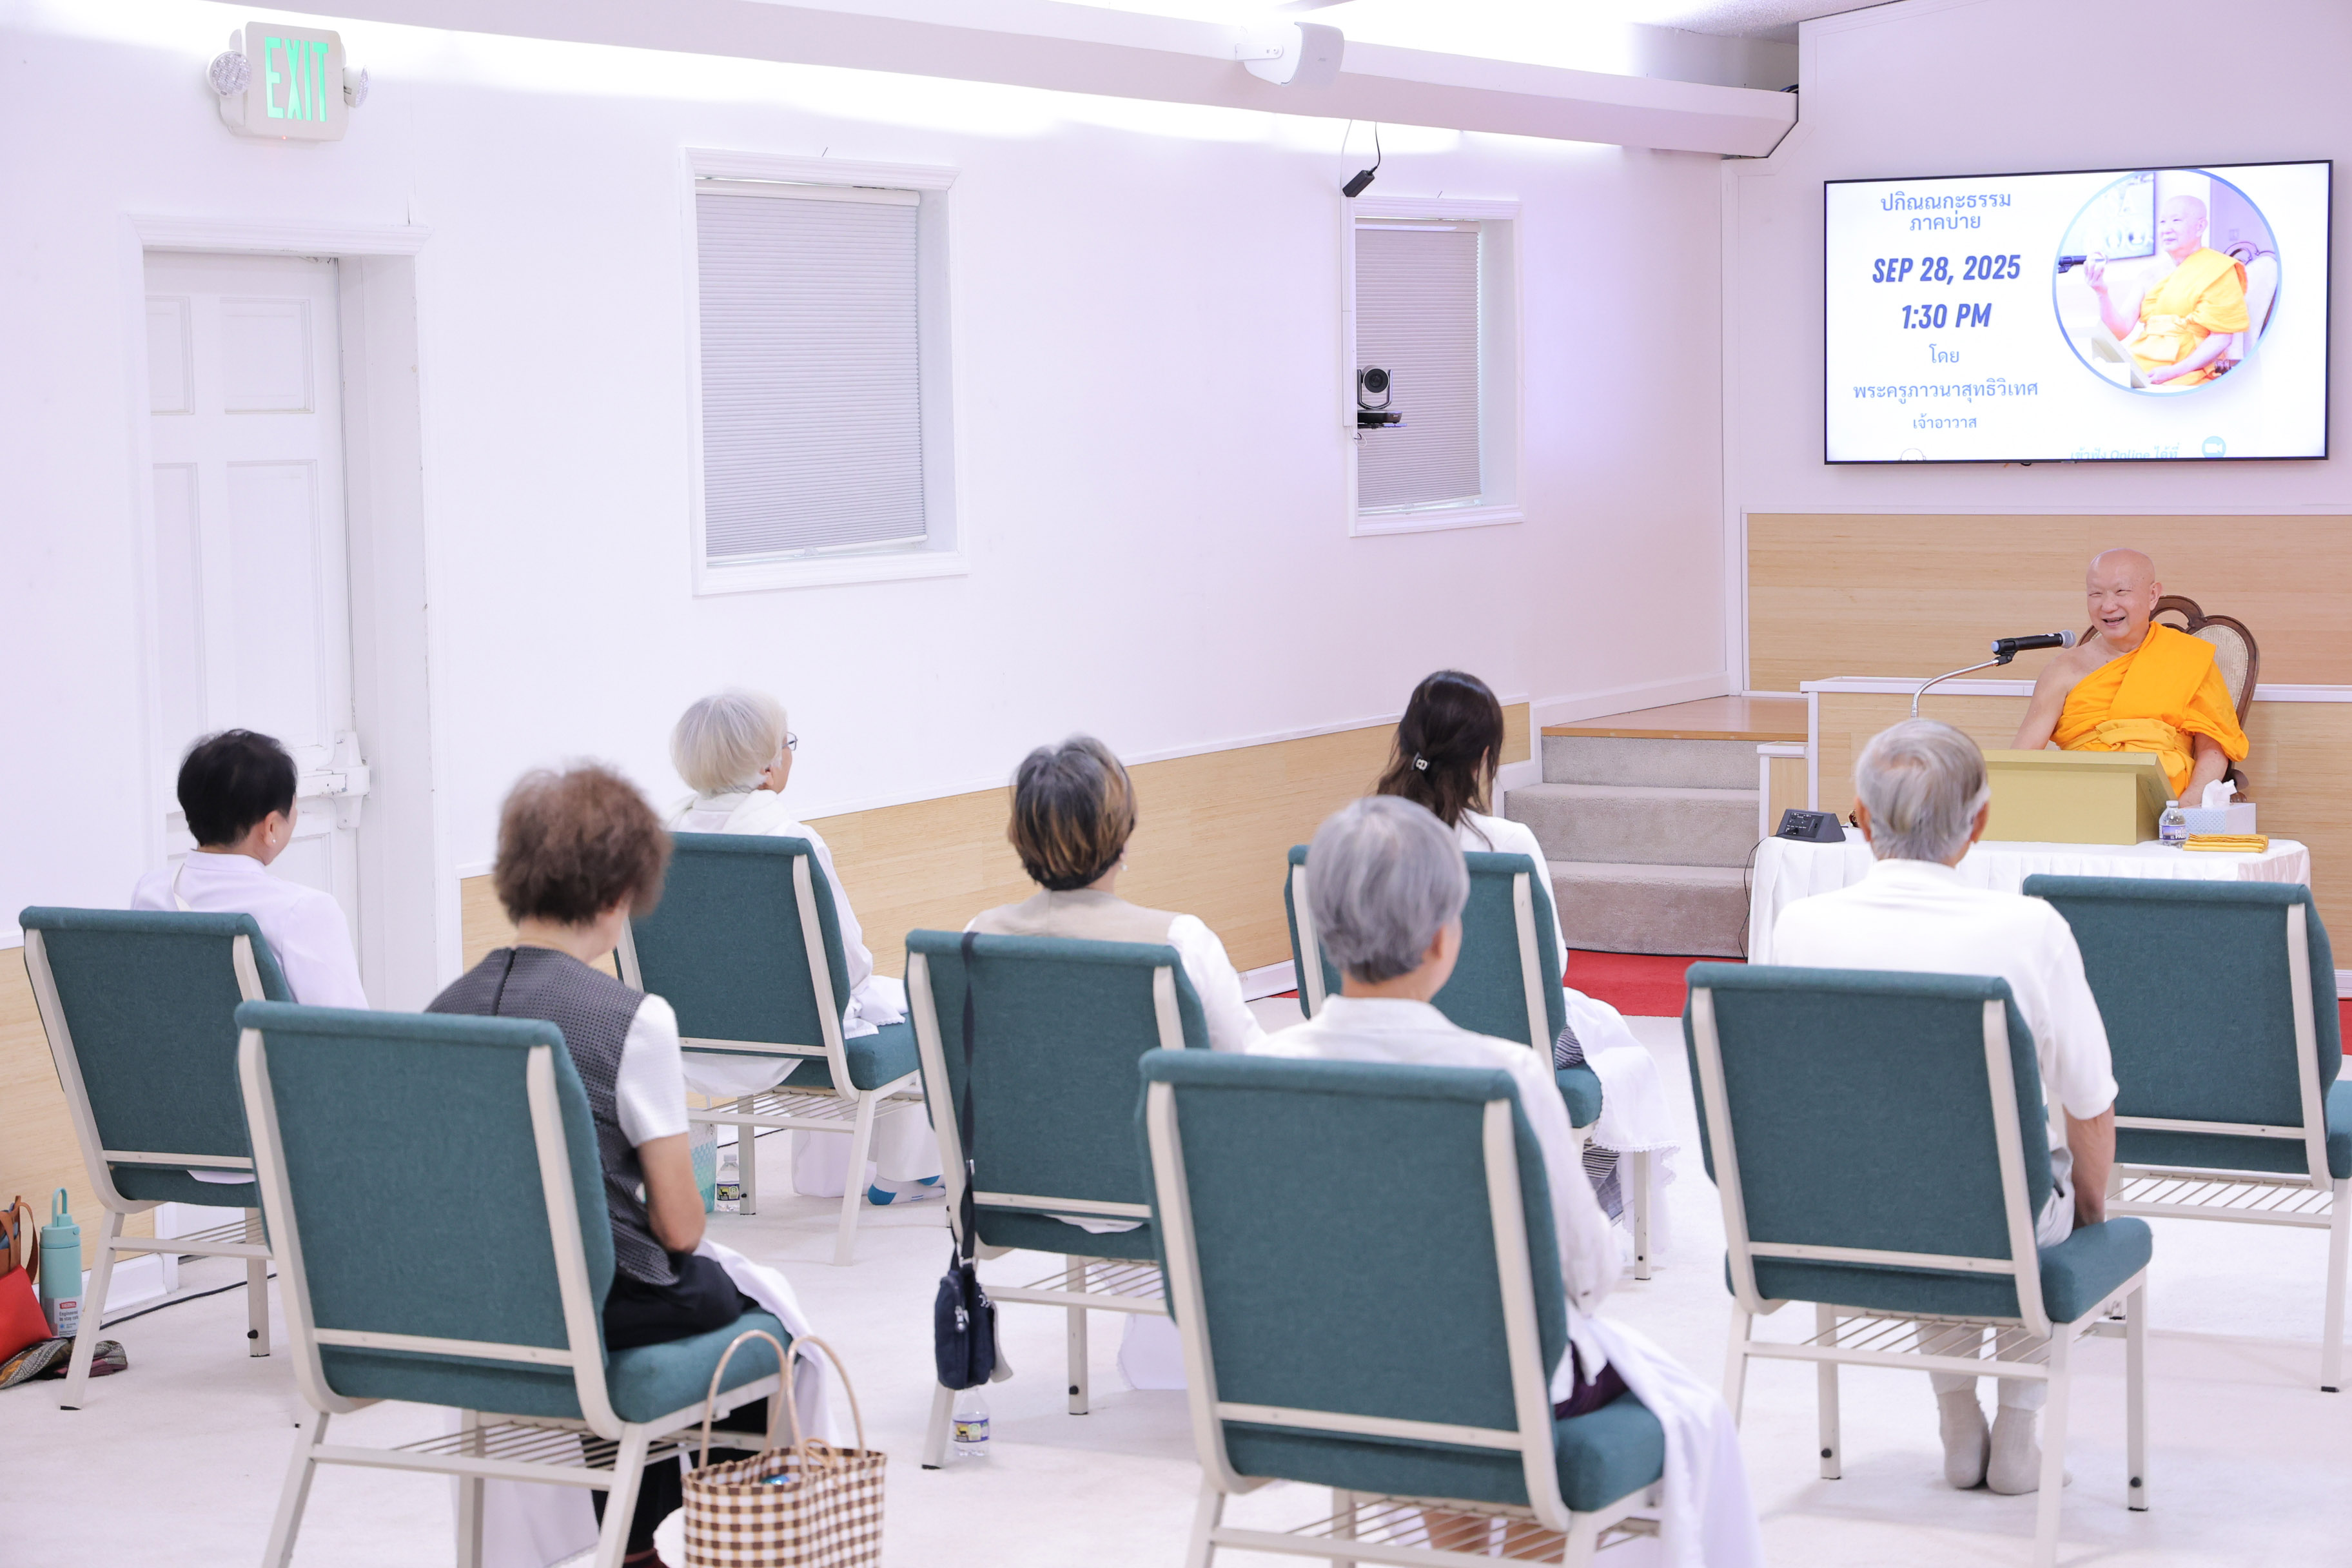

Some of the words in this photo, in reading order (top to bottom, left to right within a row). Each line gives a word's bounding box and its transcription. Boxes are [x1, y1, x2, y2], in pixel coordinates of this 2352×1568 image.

[264, 36, 328, 122] EXIT
[1881, 191, 2010, 211] ปกิณณกะธรรม
[1910, 210, 1981, 231] ภาคบ่าย
[1872, 258, 1914, 283] SEP
[1920, 257, 1954, 285] 28,
[1963, 254, 2021, 280] 2025
[1902, 304, 1947, 329] 1:30
[1955, 303, 1992, 328] PM
[1929, 344, 1959, 363] โดย
[1853, 378, 2037, 404] พระครูภาวนาสุทธิวิเทศ
[1914, 413, 1977, 429] เจ้าอาวาส
